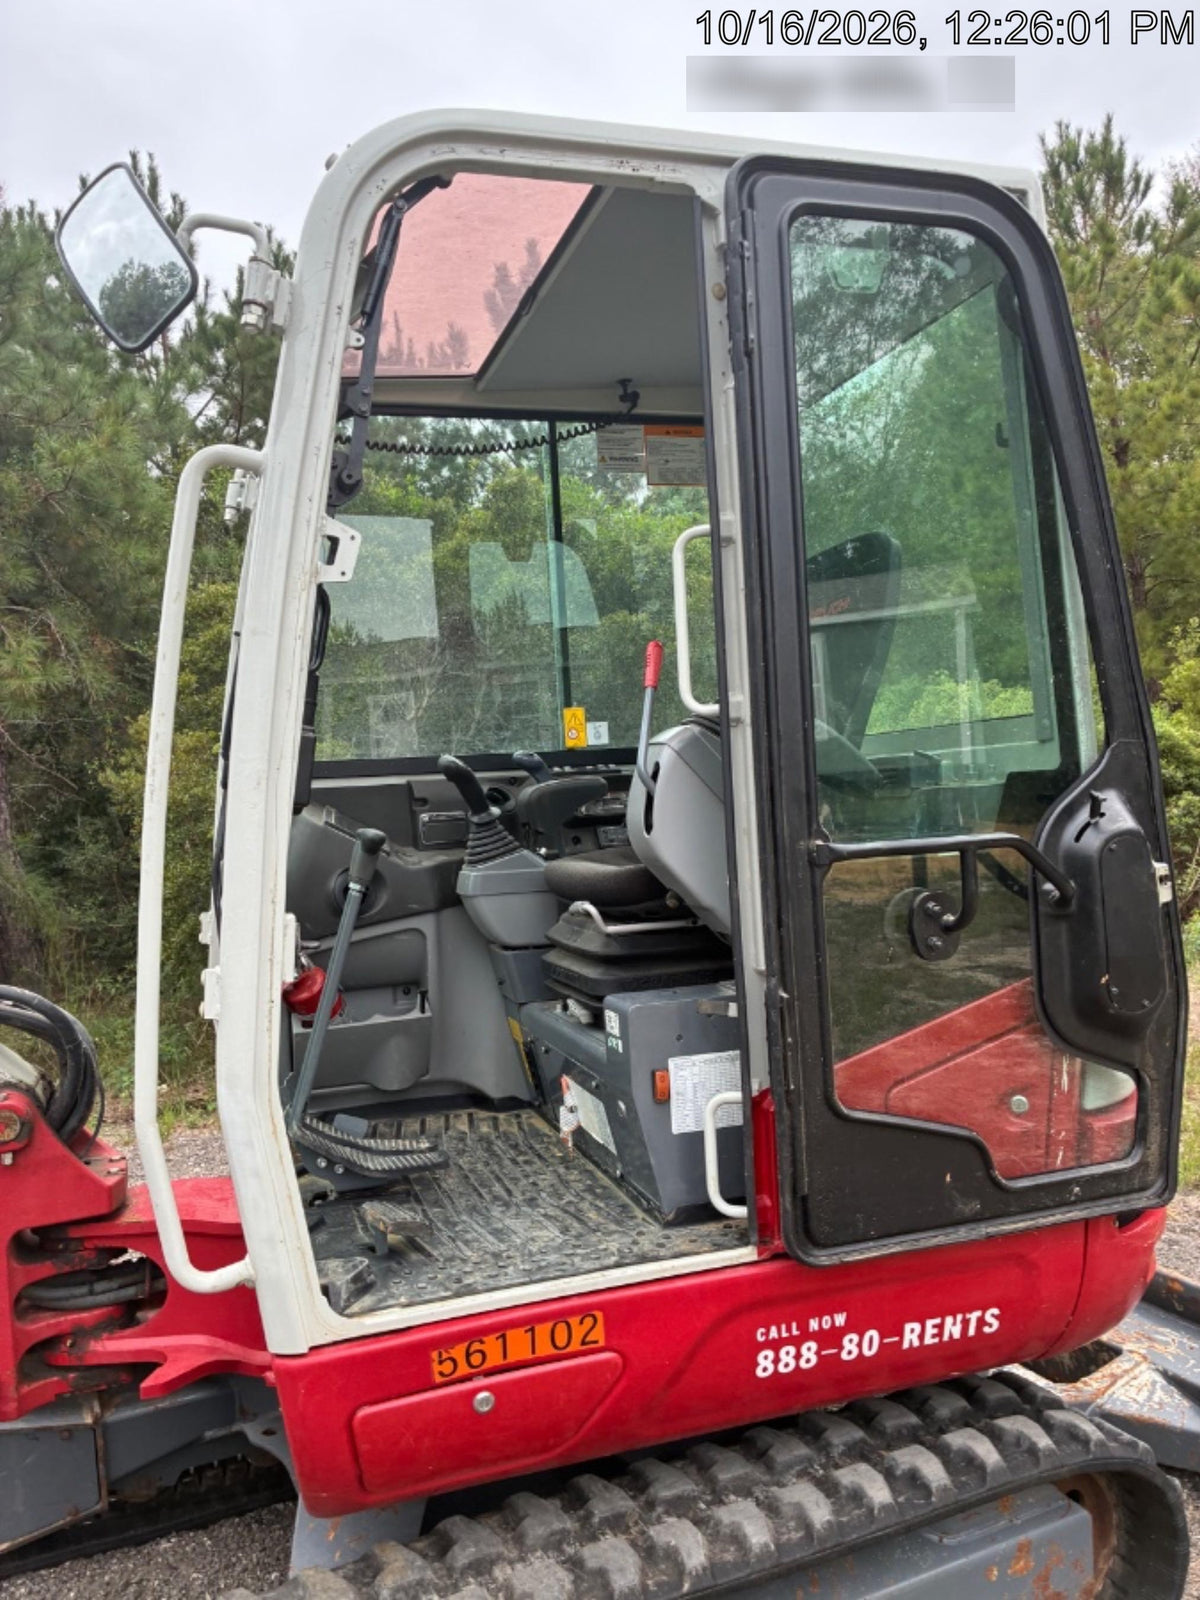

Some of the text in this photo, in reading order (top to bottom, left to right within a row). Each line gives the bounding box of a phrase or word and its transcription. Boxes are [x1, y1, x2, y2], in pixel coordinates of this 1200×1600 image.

[436, 1313, 601, 1379] 561102
[755, 1307, 1001, 1378] 888-80-RENTS
[756, 1311, 847, 1342] CALL NOW
